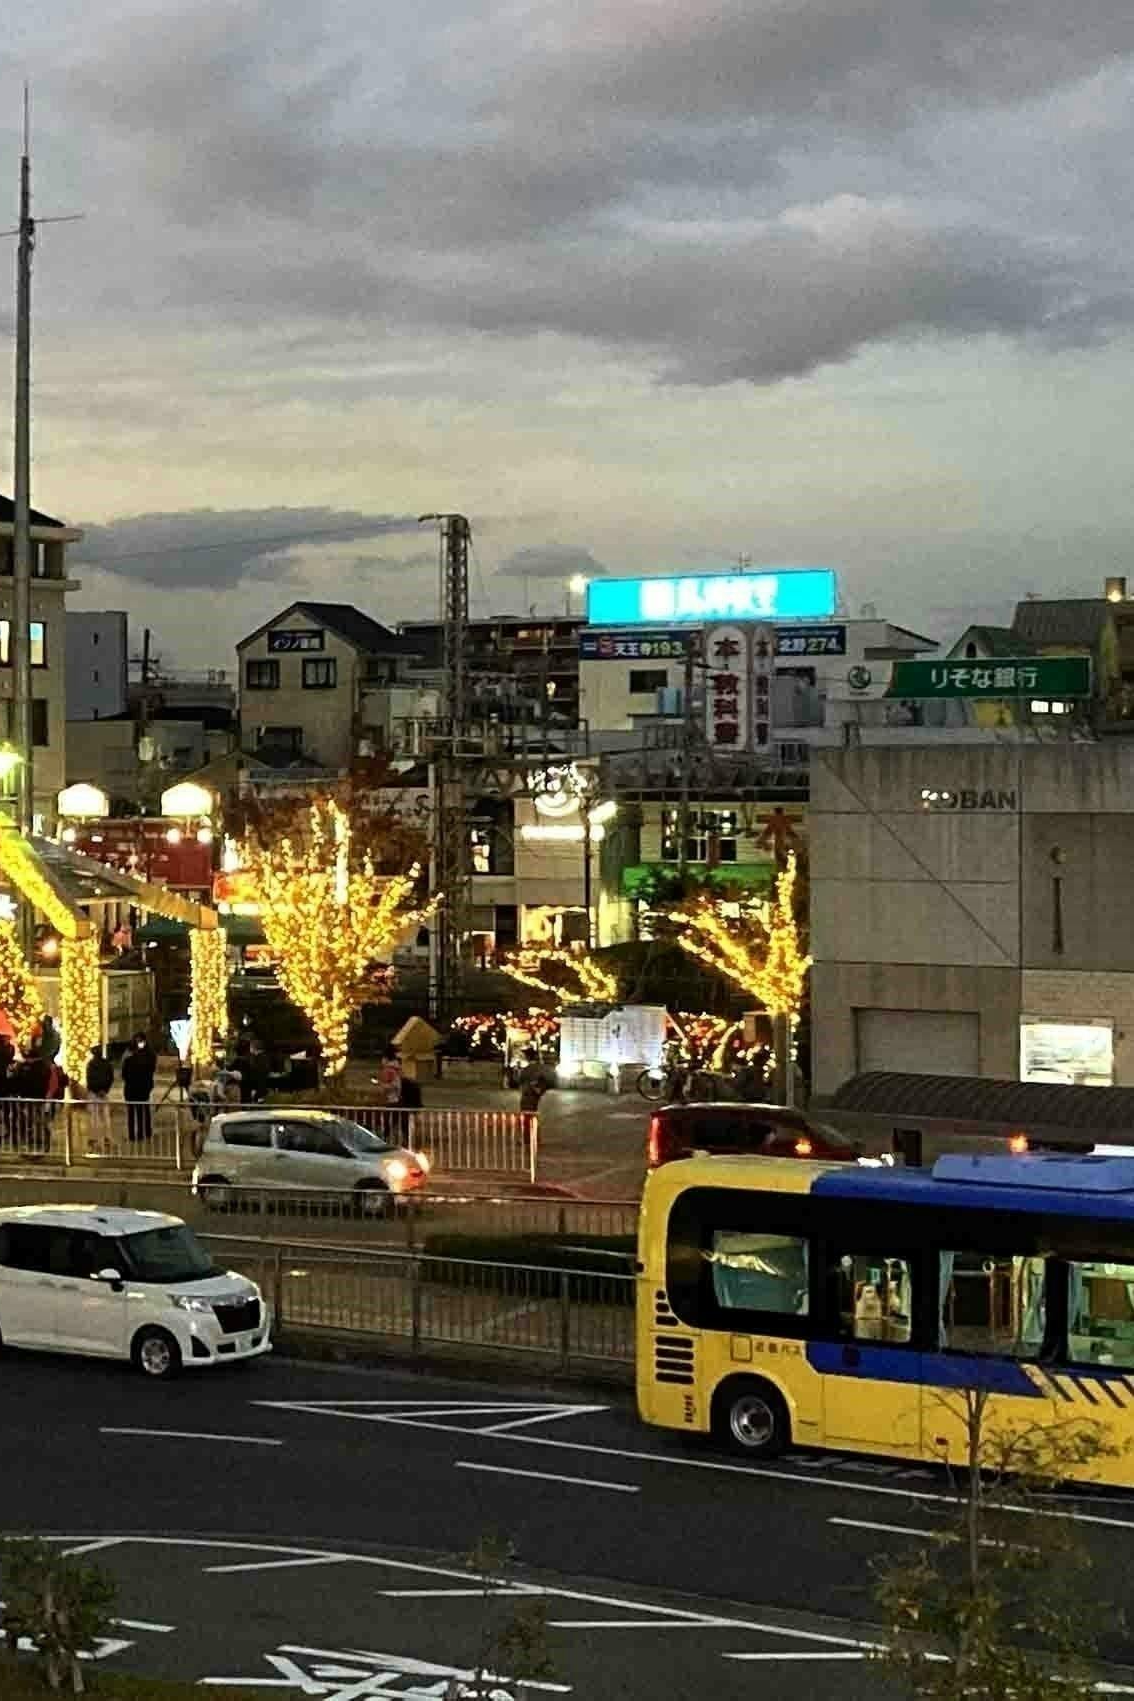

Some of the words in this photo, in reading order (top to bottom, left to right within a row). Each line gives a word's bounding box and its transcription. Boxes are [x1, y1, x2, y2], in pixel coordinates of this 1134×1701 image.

[931, 667, 1039, 689] りそな銀行
